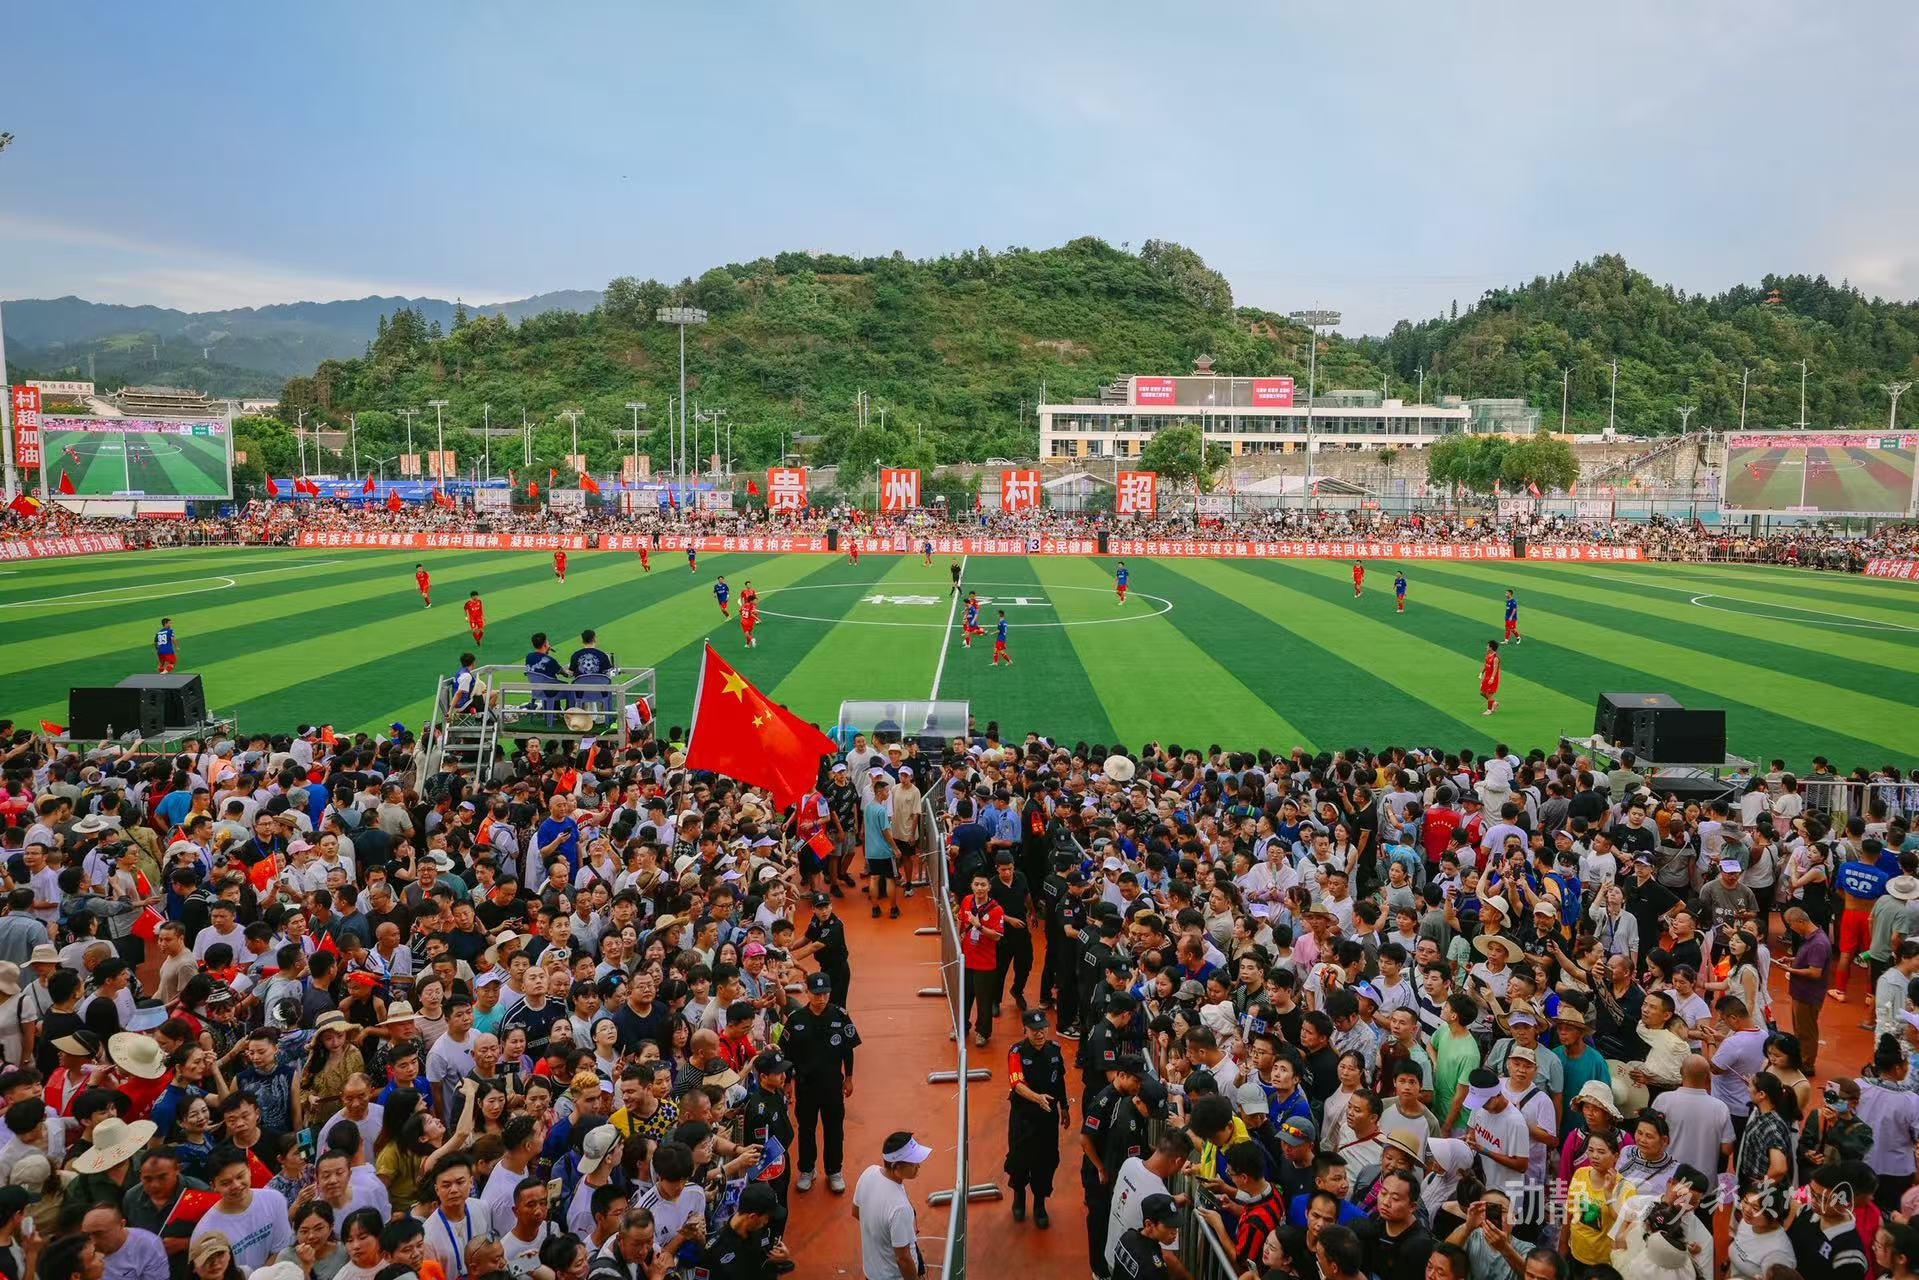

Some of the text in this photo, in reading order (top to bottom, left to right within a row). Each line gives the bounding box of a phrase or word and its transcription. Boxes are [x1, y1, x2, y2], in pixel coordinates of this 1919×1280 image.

[16, 391, 40, 463] 村超加油
[769, 470, 1153, 512] 贵 州 村 超
[511, 535, 584, 549] 凝聚中华力量
[607, 537, 822, 551] 各民族石榴籽一样紧紧抱在一起
[971, 540, 1021, 553] 村超加油
[1031, 539, 1040, 550] 3
[1043, 540, 1093, 553] 全民健康
[1107, 541, 1511, 558] 促进各民族交往交流交融 铸牢中华民族共同体意识 快乐村超 活力四射
[1529, 547, 1638, 560] 全民健身 全民健康
[1866, 559, 1914, 579] 快乐村超
[1818, 1241, 1832, 1260] R
